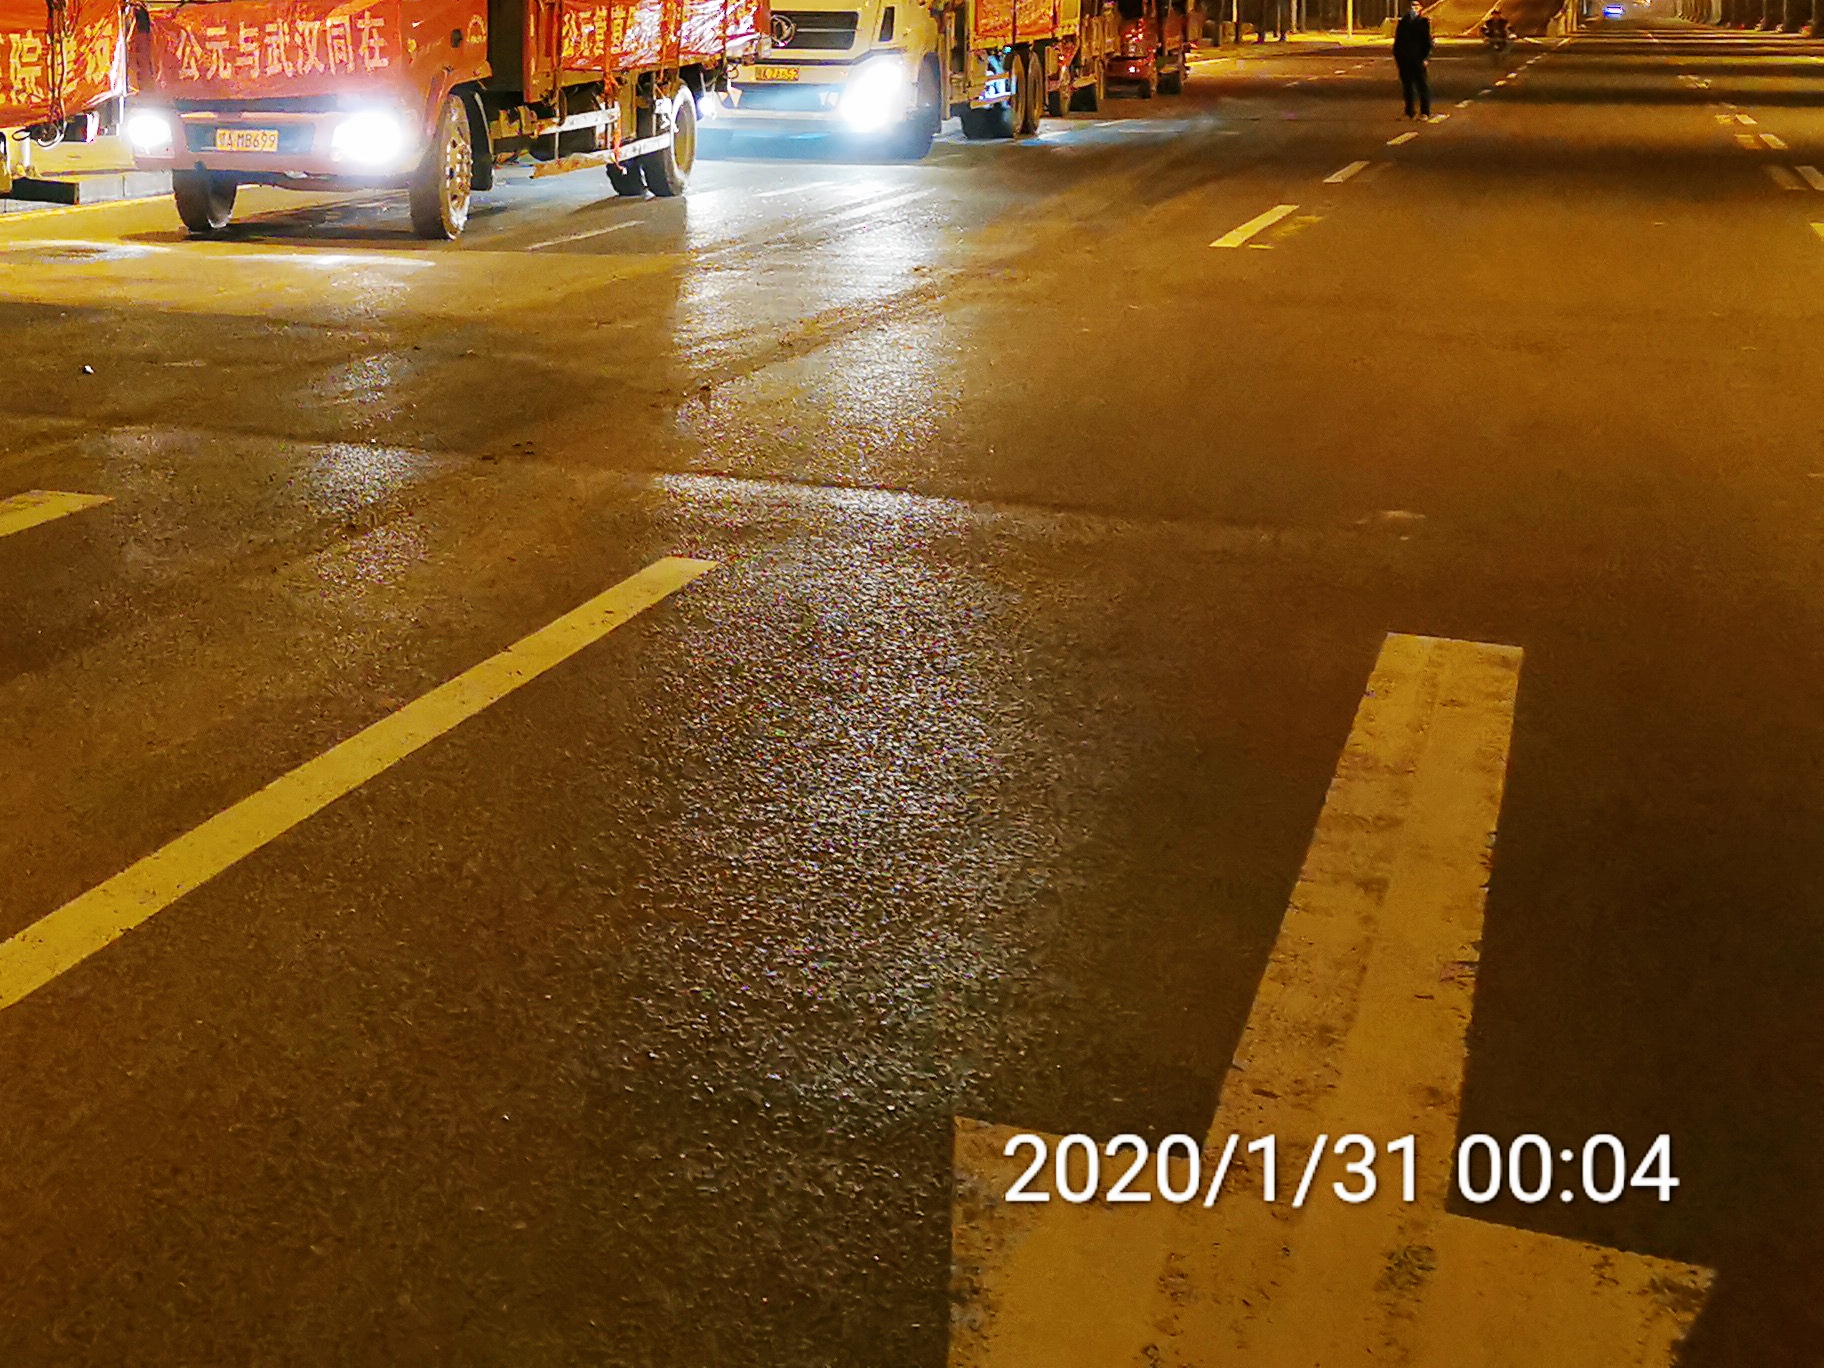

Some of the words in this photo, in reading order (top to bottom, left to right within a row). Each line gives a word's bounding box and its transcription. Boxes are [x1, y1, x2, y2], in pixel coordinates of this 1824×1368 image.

[176, 10, 389, 81] 公元与武汉同在
